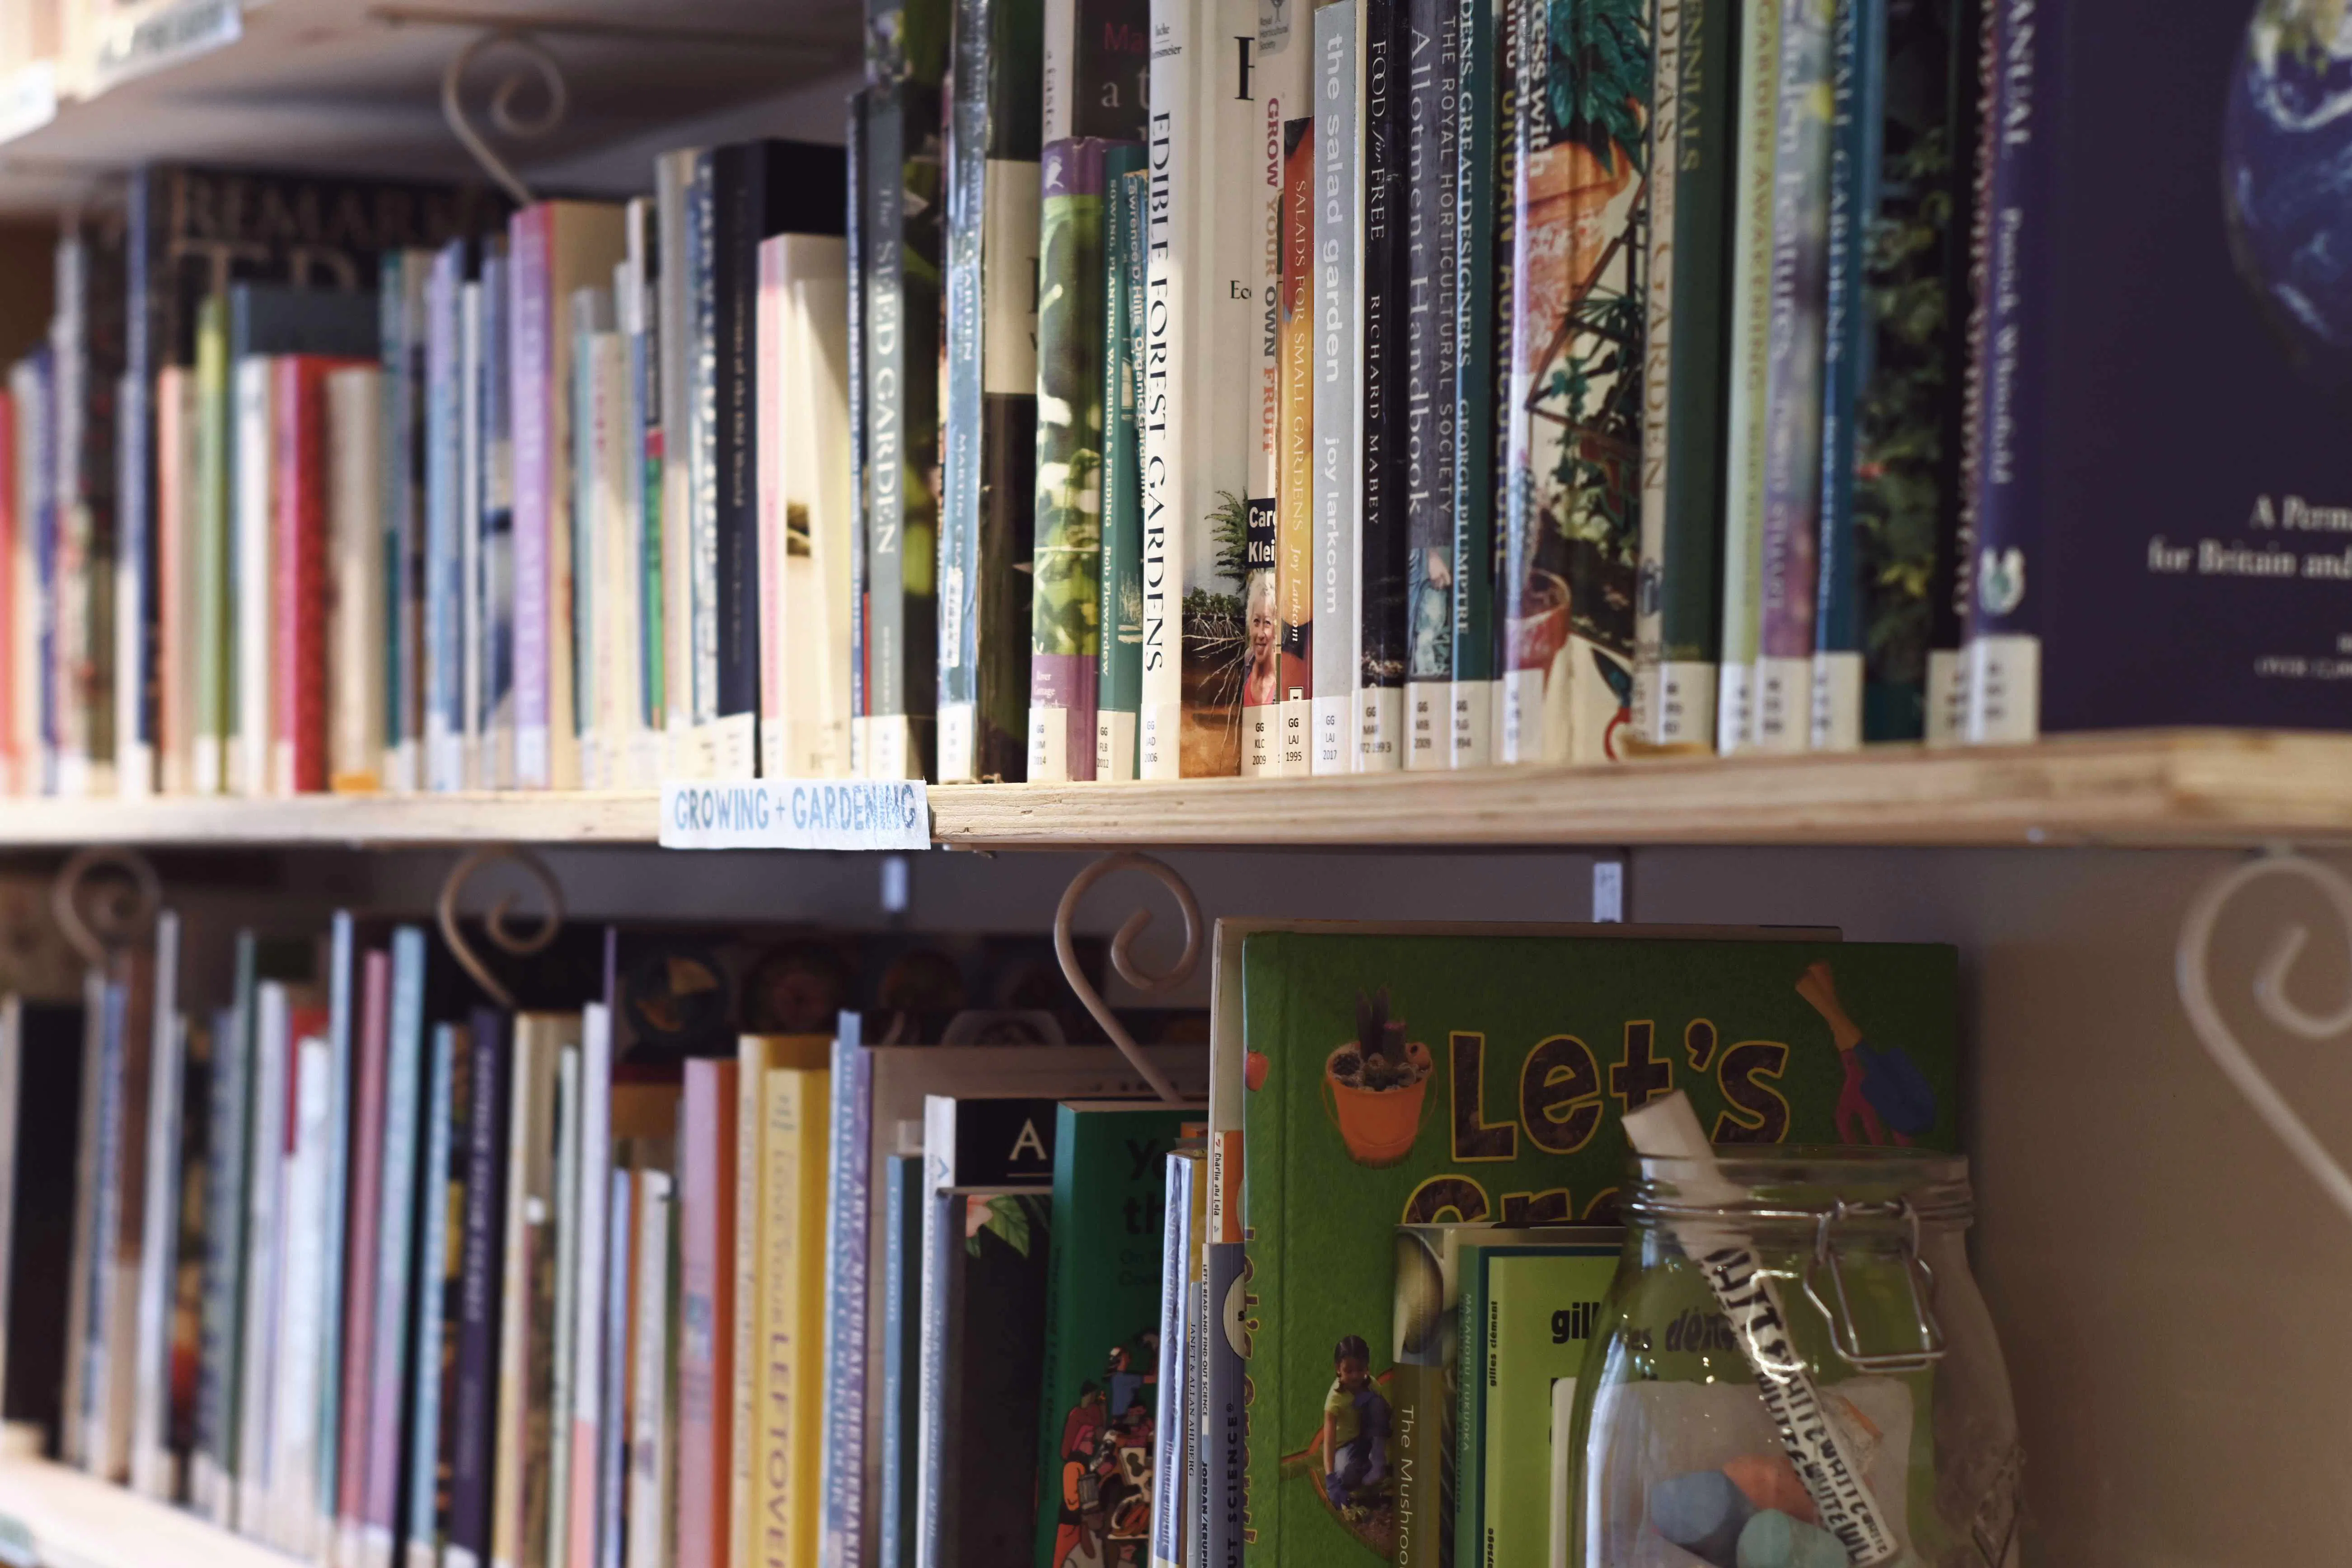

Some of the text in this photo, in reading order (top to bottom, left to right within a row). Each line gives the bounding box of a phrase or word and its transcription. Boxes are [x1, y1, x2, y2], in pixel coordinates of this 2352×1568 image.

[1529, 0, 1553, 178] cess with
[1657, 4, 1677, 144] DEAS
[1371, 39, 1386, 241] FOOD for FREE
[1458, 0, 1473, 367] DENS, GREAT DESIGNERS
[1323, 34, 1343, 383] the salad garden
[1107, 256, 1116, 342] PLANTING,
[1262, 98, 1279, 457] GROW YOUR OWN FRUIT
[1409, 25, 1431, 516] Allotment Handbook
[1438, 16, 1456, 514] THE ROYAL HORTICULTURAL SOCIETY
[1106, 348, 1115, 436] WATERING
[1131, 337, 1145, 407] Organic
[1146, 112, 1171, 672] EDIBLE FOREST GARDENS
[1290, 181, 1306, 642] SALADS FOR SMALL GARDENS Joy Larkcom
[1368, 295, 1380, 524] RICHARD MABEY
[875, 367, 896, 553] GARDEN
[1106, 441, 1112, 453] &
[1248, 541, 1275, 562] Klei
[1324, 437, 1340, 613] joy larkcom
[1456, 399, 1470, 635] GEORGE PLUMPTRE
[2283, 496, 2352, 533] Perm
[1102, 581, 1111, 676] Flowerdew
[1100, 727, 1108, 736] GG
[1252, 755, 1266, 765] 2009
[1255, 739, 1265, 749] KLC
[1256, 722, 1265, 732] GG
[1286, 751, 1302, 762] 1995
[1288, 718, 1299, 728] GG
[1288, 735, 1299, 744] LAJ
[1323, 749, 1337, 760] 2017
[1325, 732, 1335, 743] LAJ
[1326, 715, 1335, 725] GG
[673, 784, 916, 831] GROWING + GARDENING
[1448, 1018, 1791, 1162] Let's
[1009, 1118, 1048, 1161] A
[1189, 1364, 1195, 1372] &
[1490, 1301, 1499, 1348] clément
[767, 1333, 789, 1568] LEFTOVE
[843, 1389, 862, 1568] CHEESEMAKI
[1400, 1404, 1415, 1568] The Mushroo
[1820, 1439, 1868, 1514] WHITE
